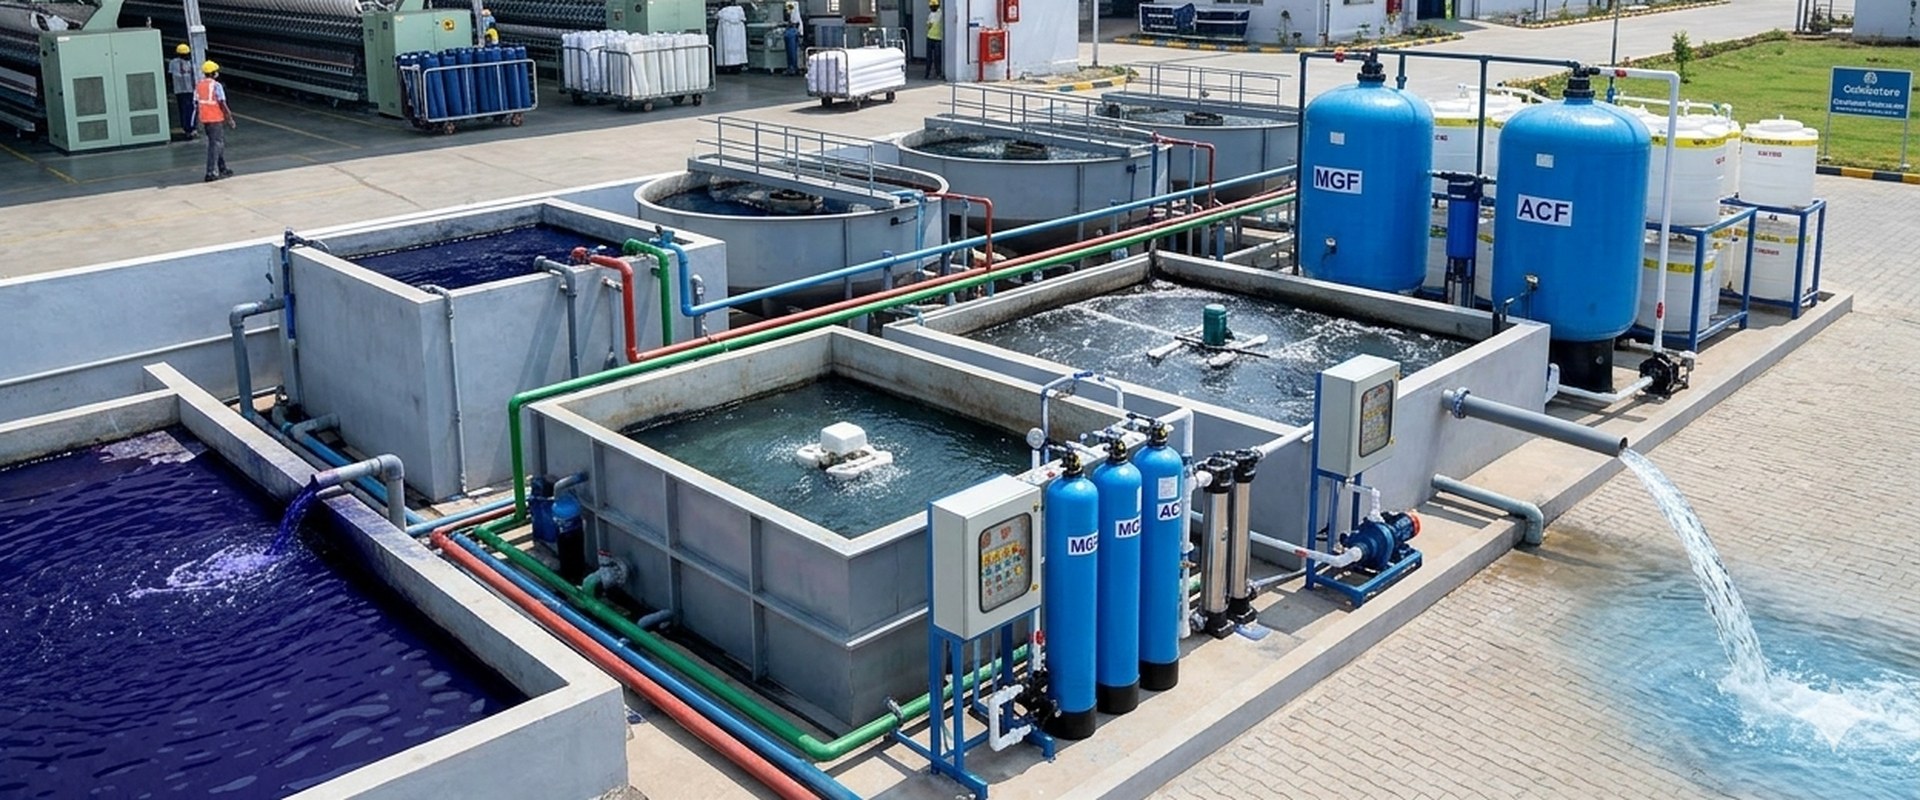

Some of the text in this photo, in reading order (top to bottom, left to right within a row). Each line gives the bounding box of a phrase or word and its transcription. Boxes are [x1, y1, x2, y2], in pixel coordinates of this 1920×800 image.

[1314, 168, 1360, 191] MGF
[1518, 198, 1570, 223] ACF
[1160, 503, 1180, 519] AC
[1118, 519, 1140, 536] MG
